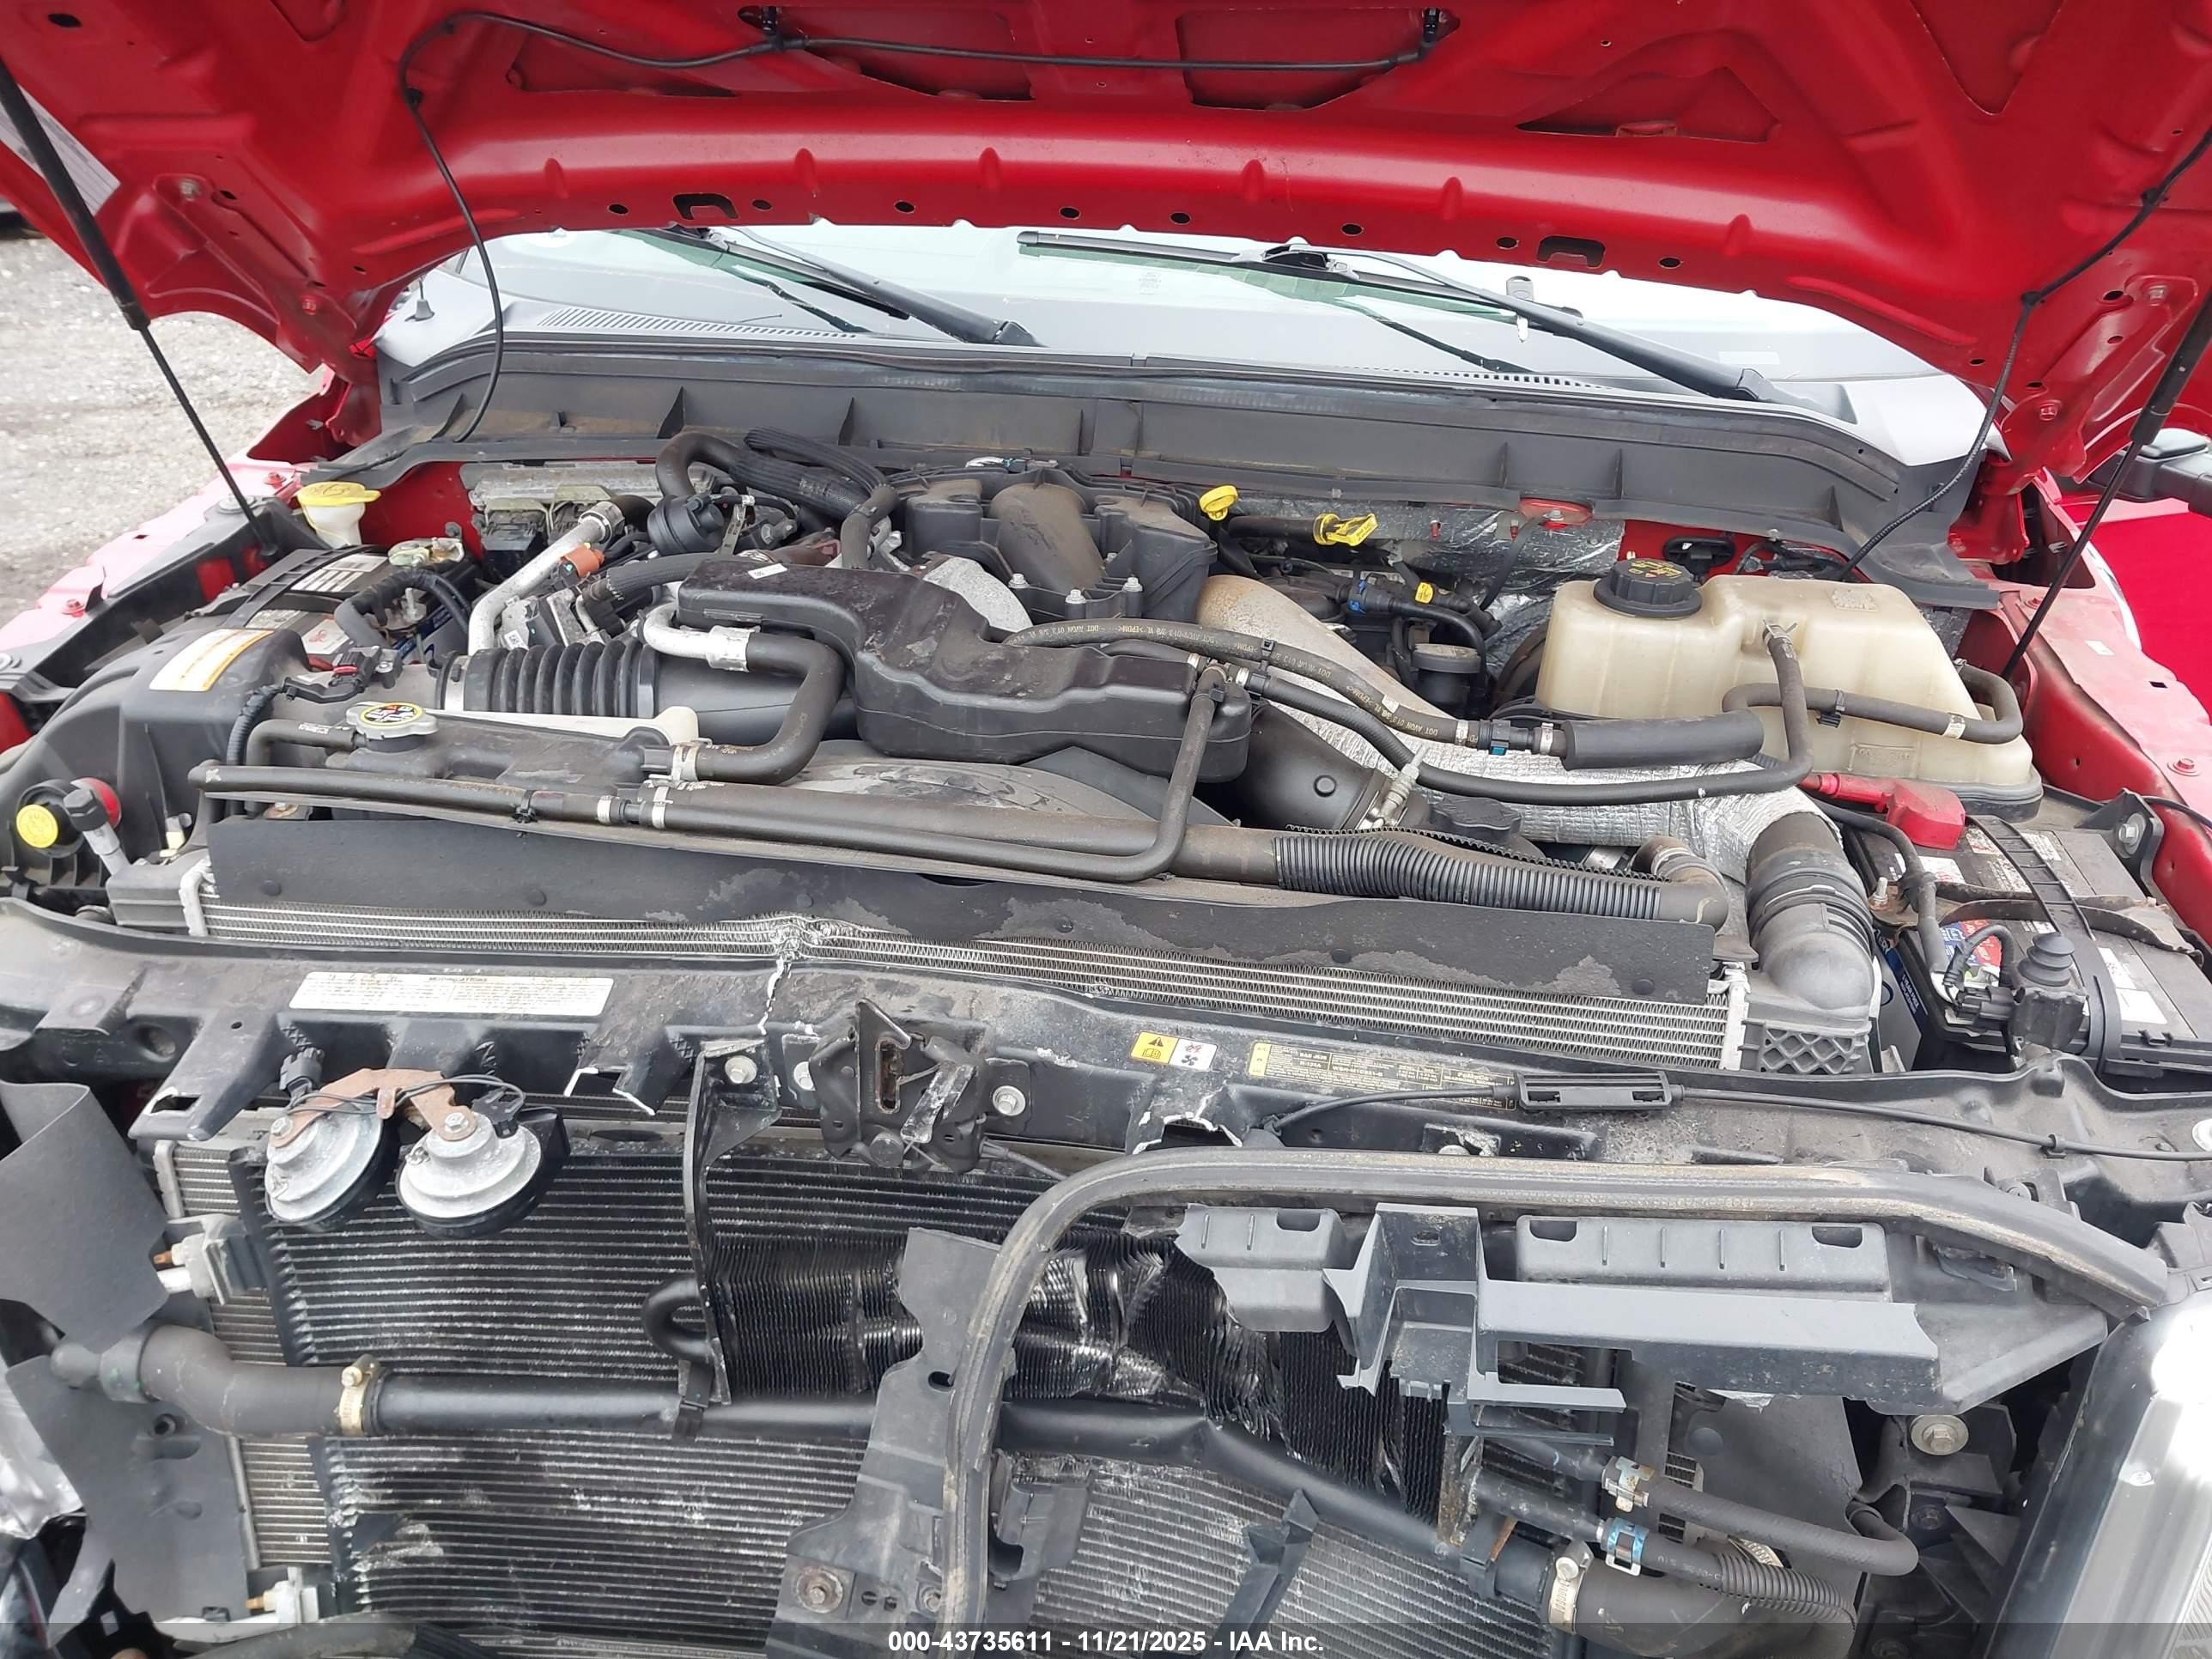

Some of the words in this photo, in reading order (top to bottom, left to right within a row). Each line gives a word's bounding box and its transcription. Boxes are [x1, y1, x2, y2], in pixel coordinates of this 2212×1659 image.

[1393, 716, 1405, 726] 013
[1406, 721, 1423, 732] AVON
[1425, 727, 1438, 736] DOT
